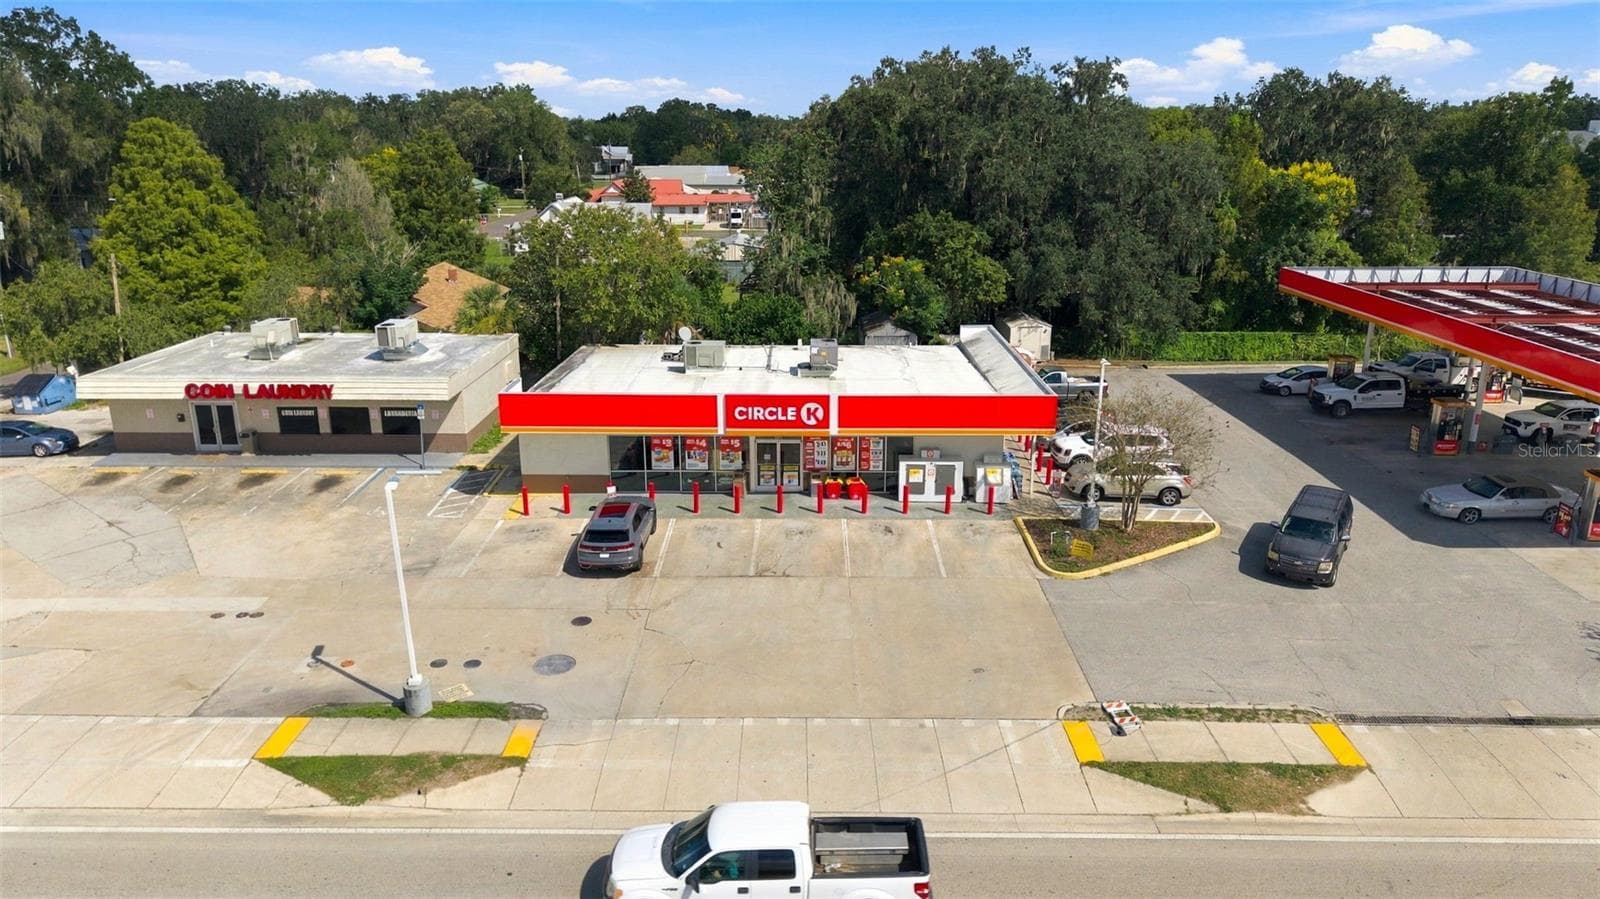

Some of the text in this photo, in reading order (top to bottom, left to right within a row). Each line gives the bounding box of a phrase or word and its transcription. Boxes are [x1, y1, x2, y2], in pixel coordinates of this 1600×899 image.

[184, 383, 334, 400] COIN LAUNDRY
[734, 406, 797, 420] CIRCLE
